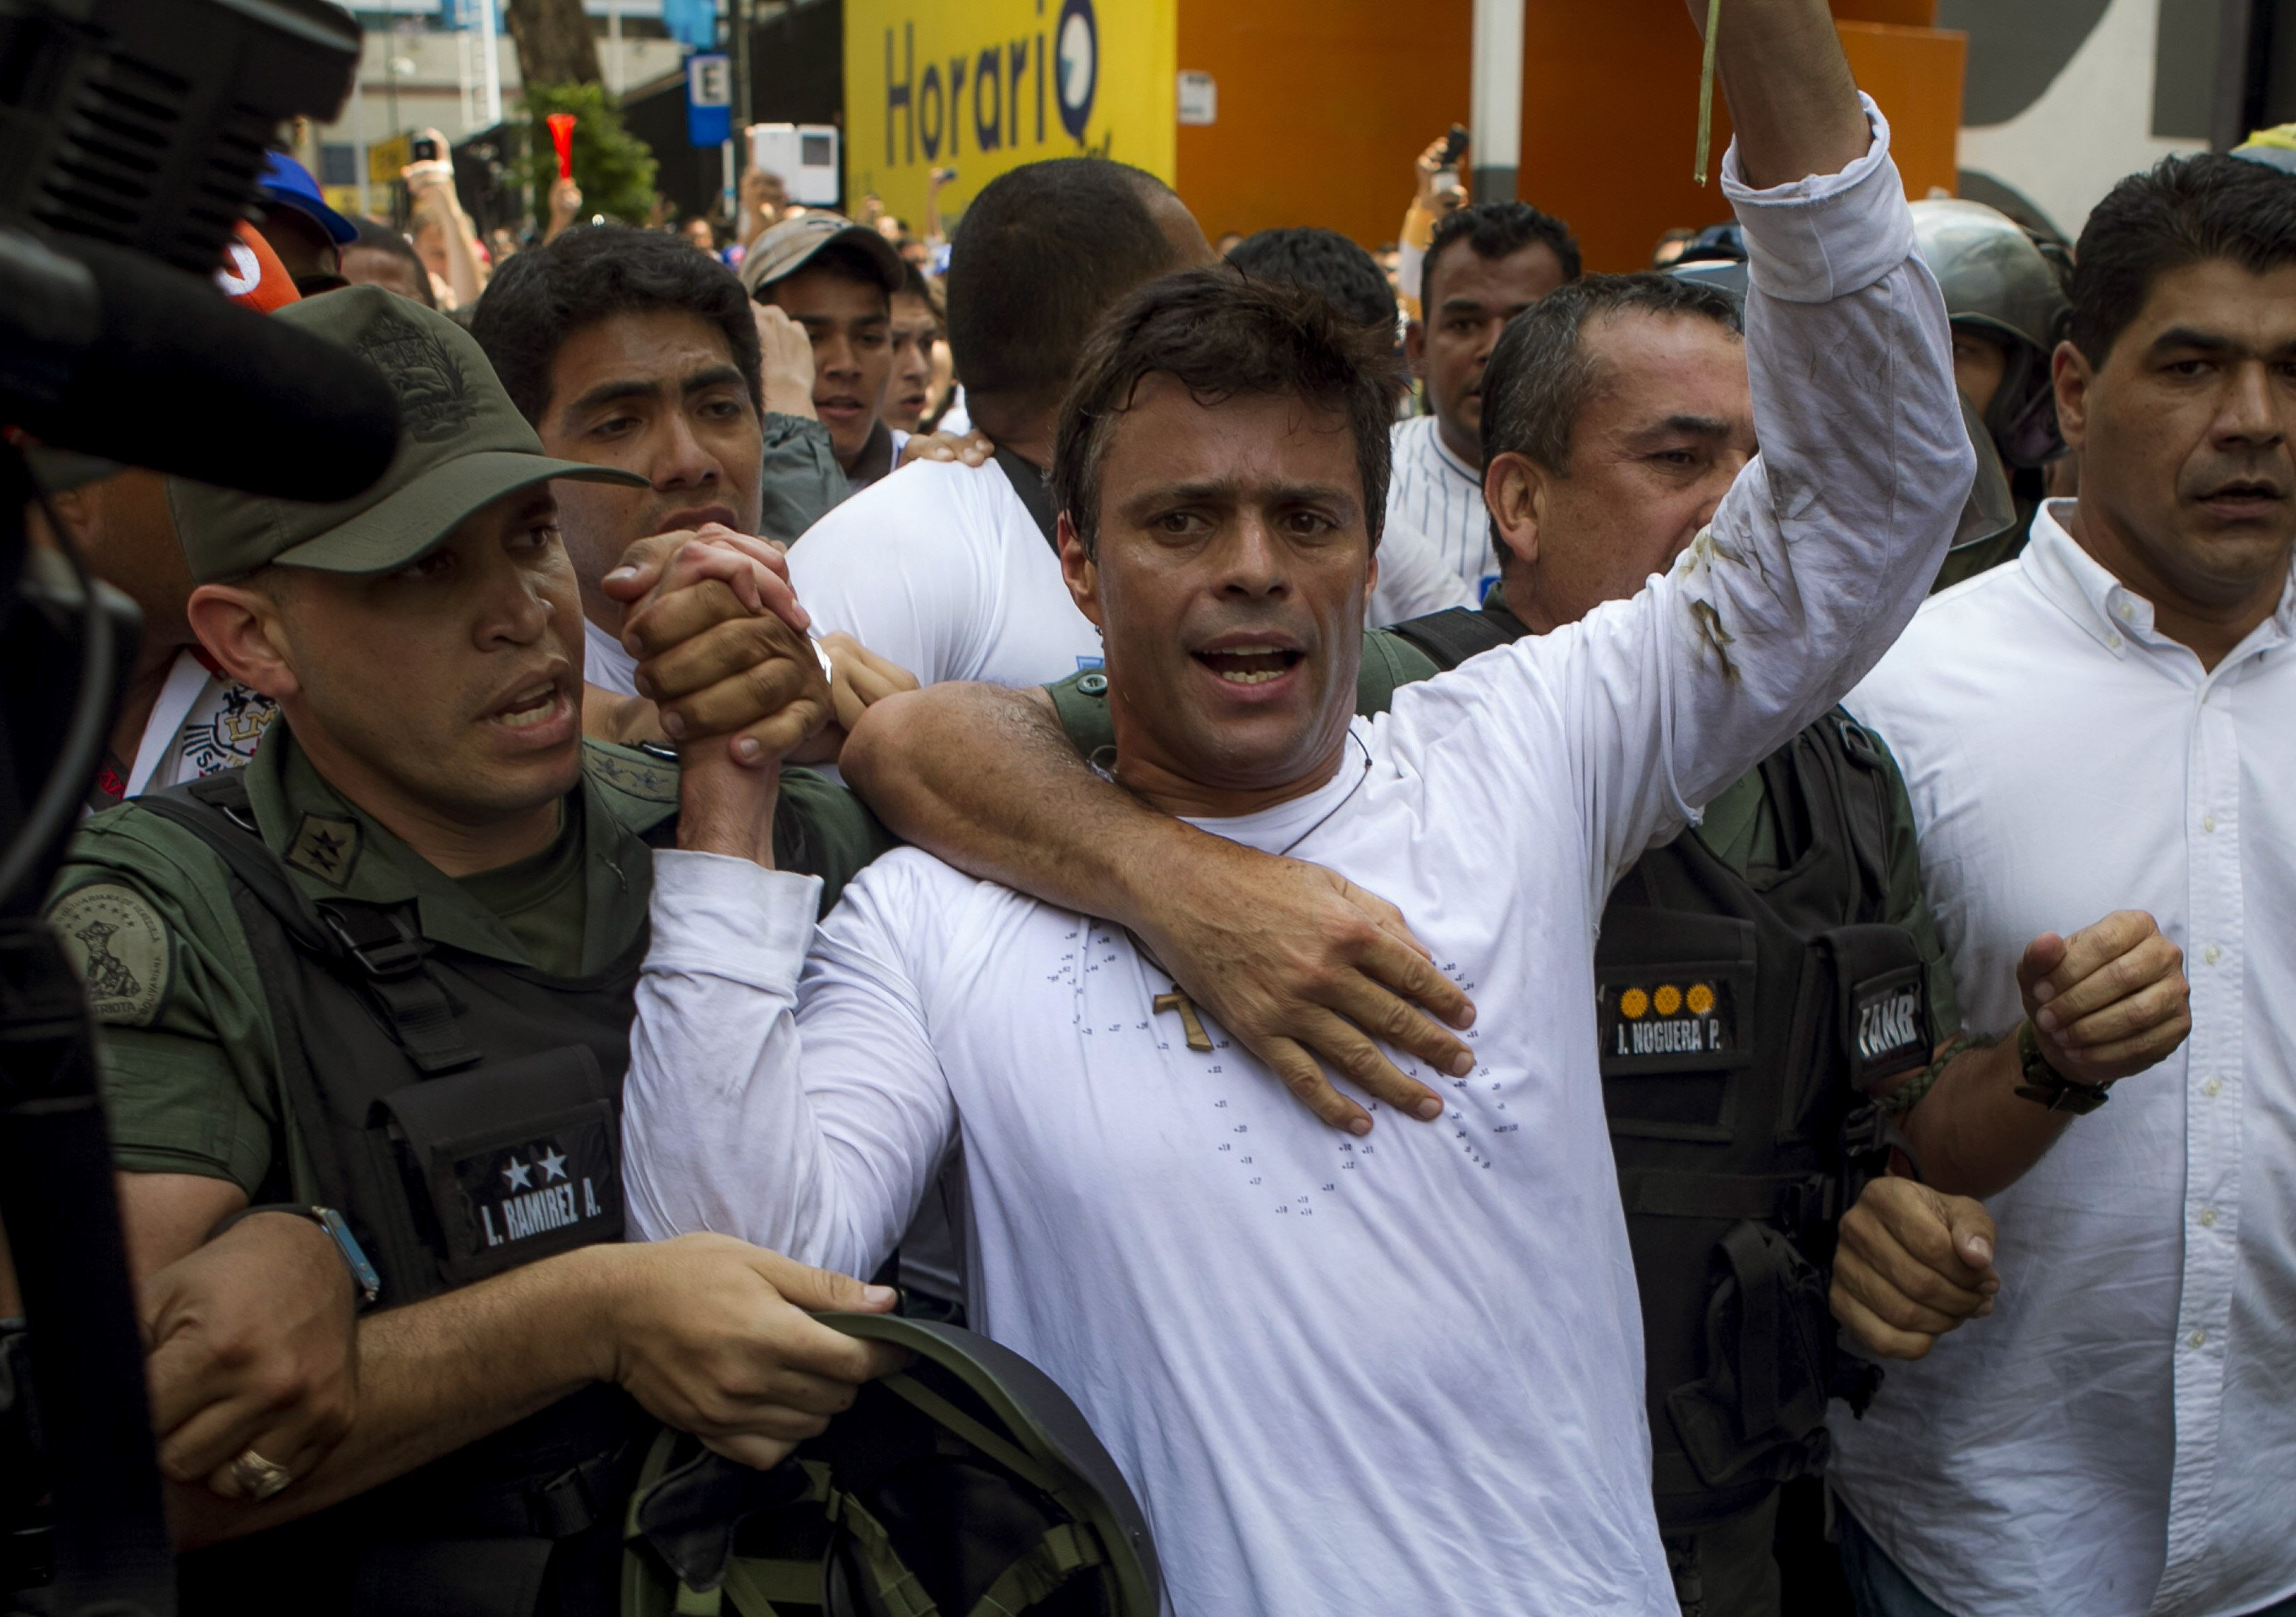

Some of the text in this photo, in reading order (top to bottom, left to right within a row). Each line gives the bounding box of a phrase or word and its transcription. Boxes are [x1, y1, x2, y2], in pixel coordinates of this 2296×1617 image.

[703, 62, 721, 99] E
[1632, 1019, 1703, 1055] NOGUERA
[1709, 1018, 1722, 1050] P.
[481, 1176, 601, 1247] L. RAMIREZ A.
